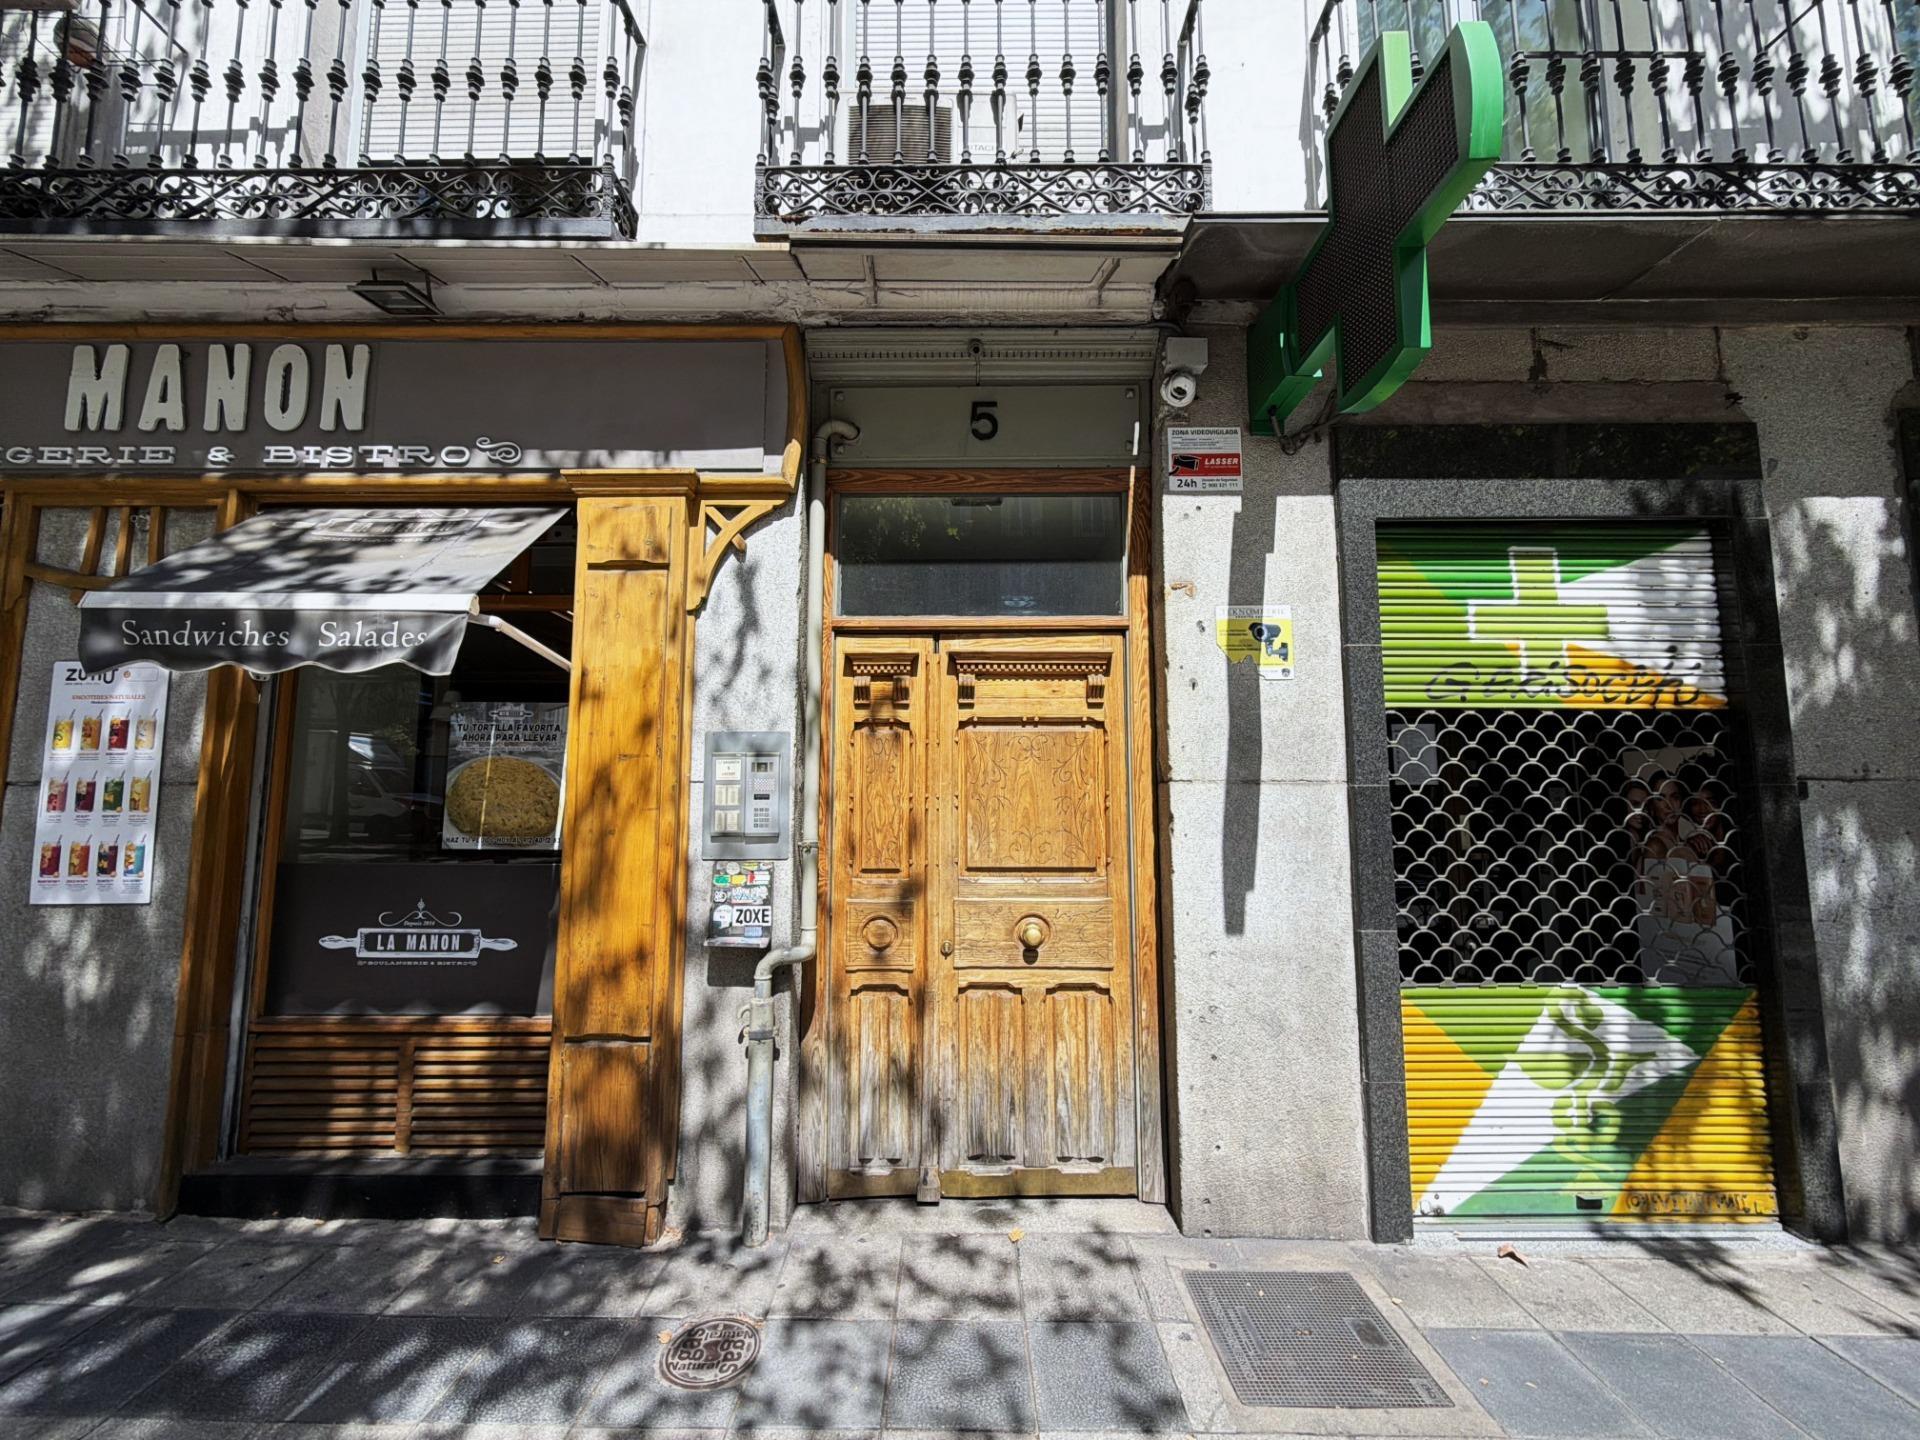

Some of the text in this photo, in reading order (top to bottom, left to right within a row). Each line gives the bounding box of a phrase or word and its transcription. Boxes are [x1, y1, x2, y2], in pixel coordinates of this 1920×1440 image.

[64, 344, 370, 432] MANON
[970, 401, 998, 441] 5
[0, 445, 470, 467] GERIE & BISTRO
[1177, 479, 1197, 488] 24h
[122, 620, 429, 648] Sandwiches Salades
[458, 723, 469, 731] TU
[473, 723, 513, 731] TORTILLA
[523, 734, 557, 742] LLEVAR
[736, 909, 770, 924] ZOXE
[376, 934, 461, 951] LA MANON
[669, 1360, 720, 1371] Natural
